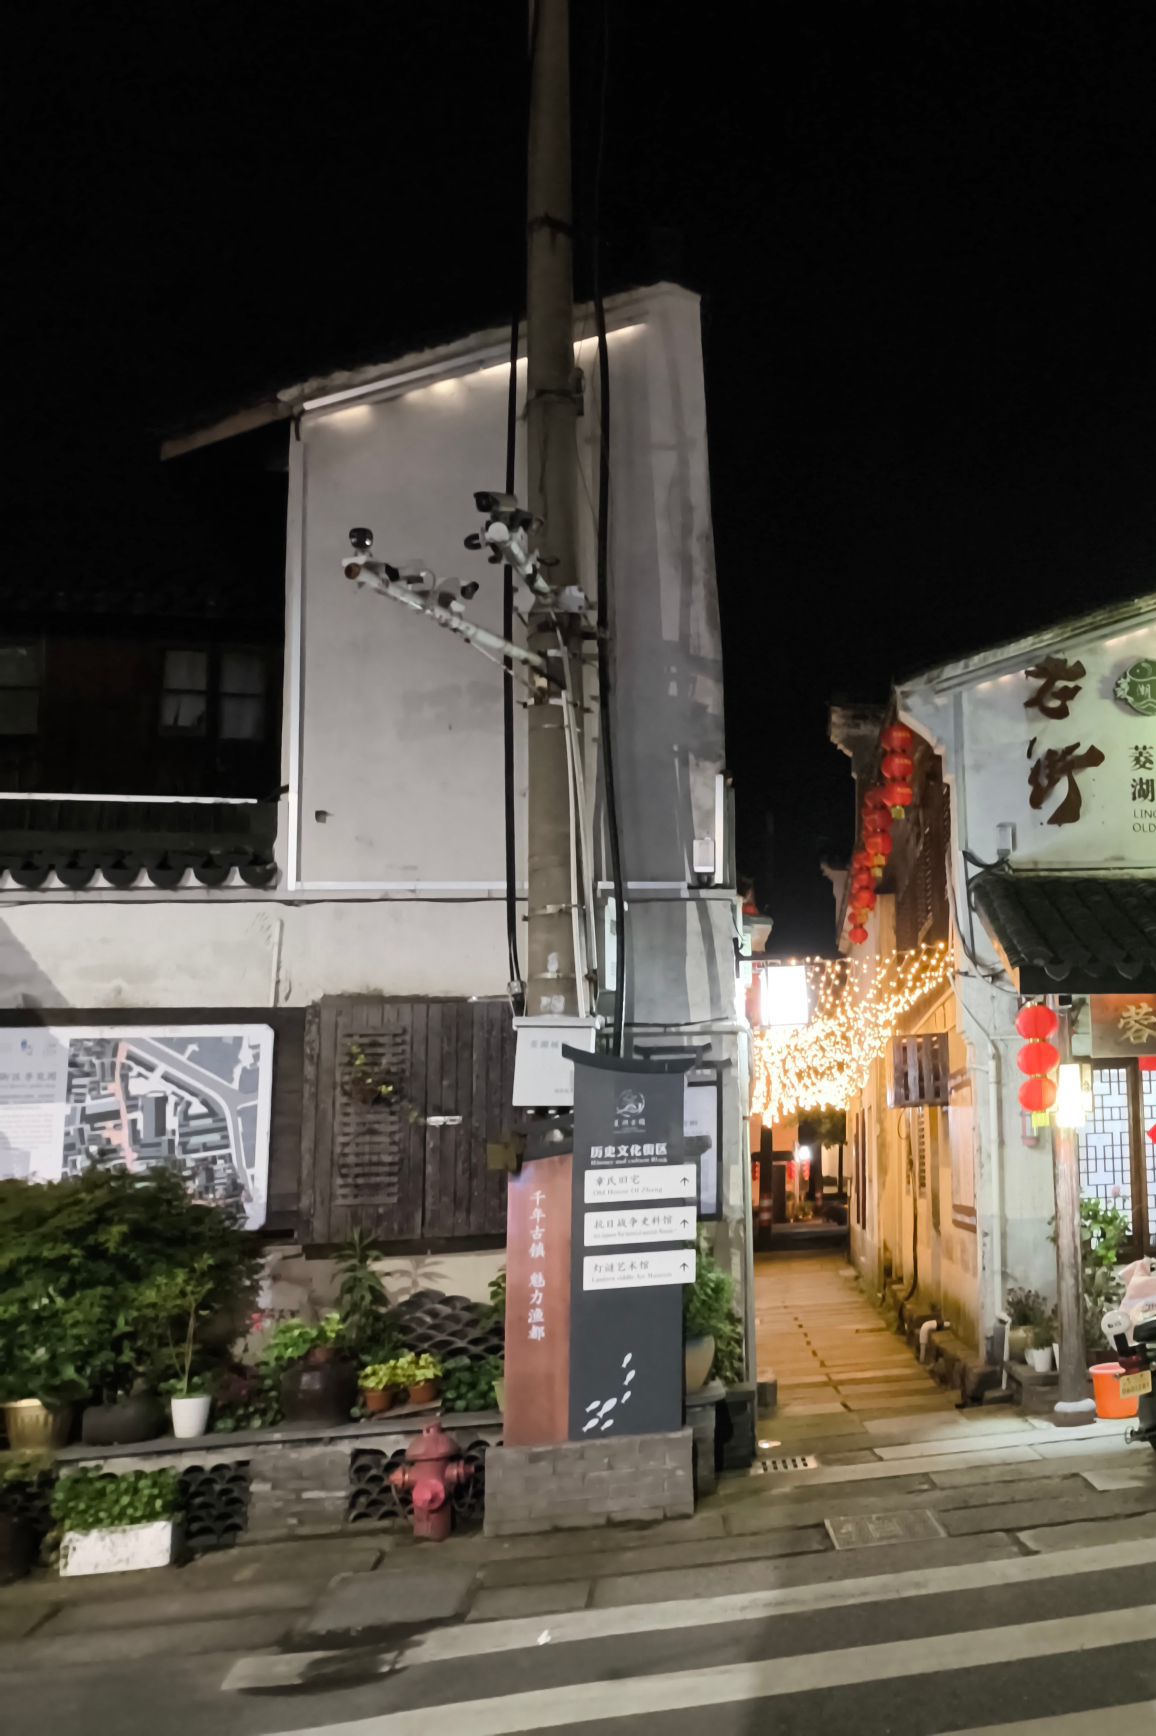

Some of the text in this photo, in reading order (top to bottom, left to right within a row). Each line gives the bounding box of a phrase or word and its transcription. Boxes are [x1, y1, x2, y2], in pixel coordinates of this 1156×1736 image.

[1129, 744, 1155, 802] 菱湖
[1132, 823, 1156, 833] OLD
[590, 1143, 667, 1158] 历史文化街区
[528, 1190, 546, 1341] 千年古镇 魅力渔都
[594, 1260, 648, 1273] 灯谜艺术馆
